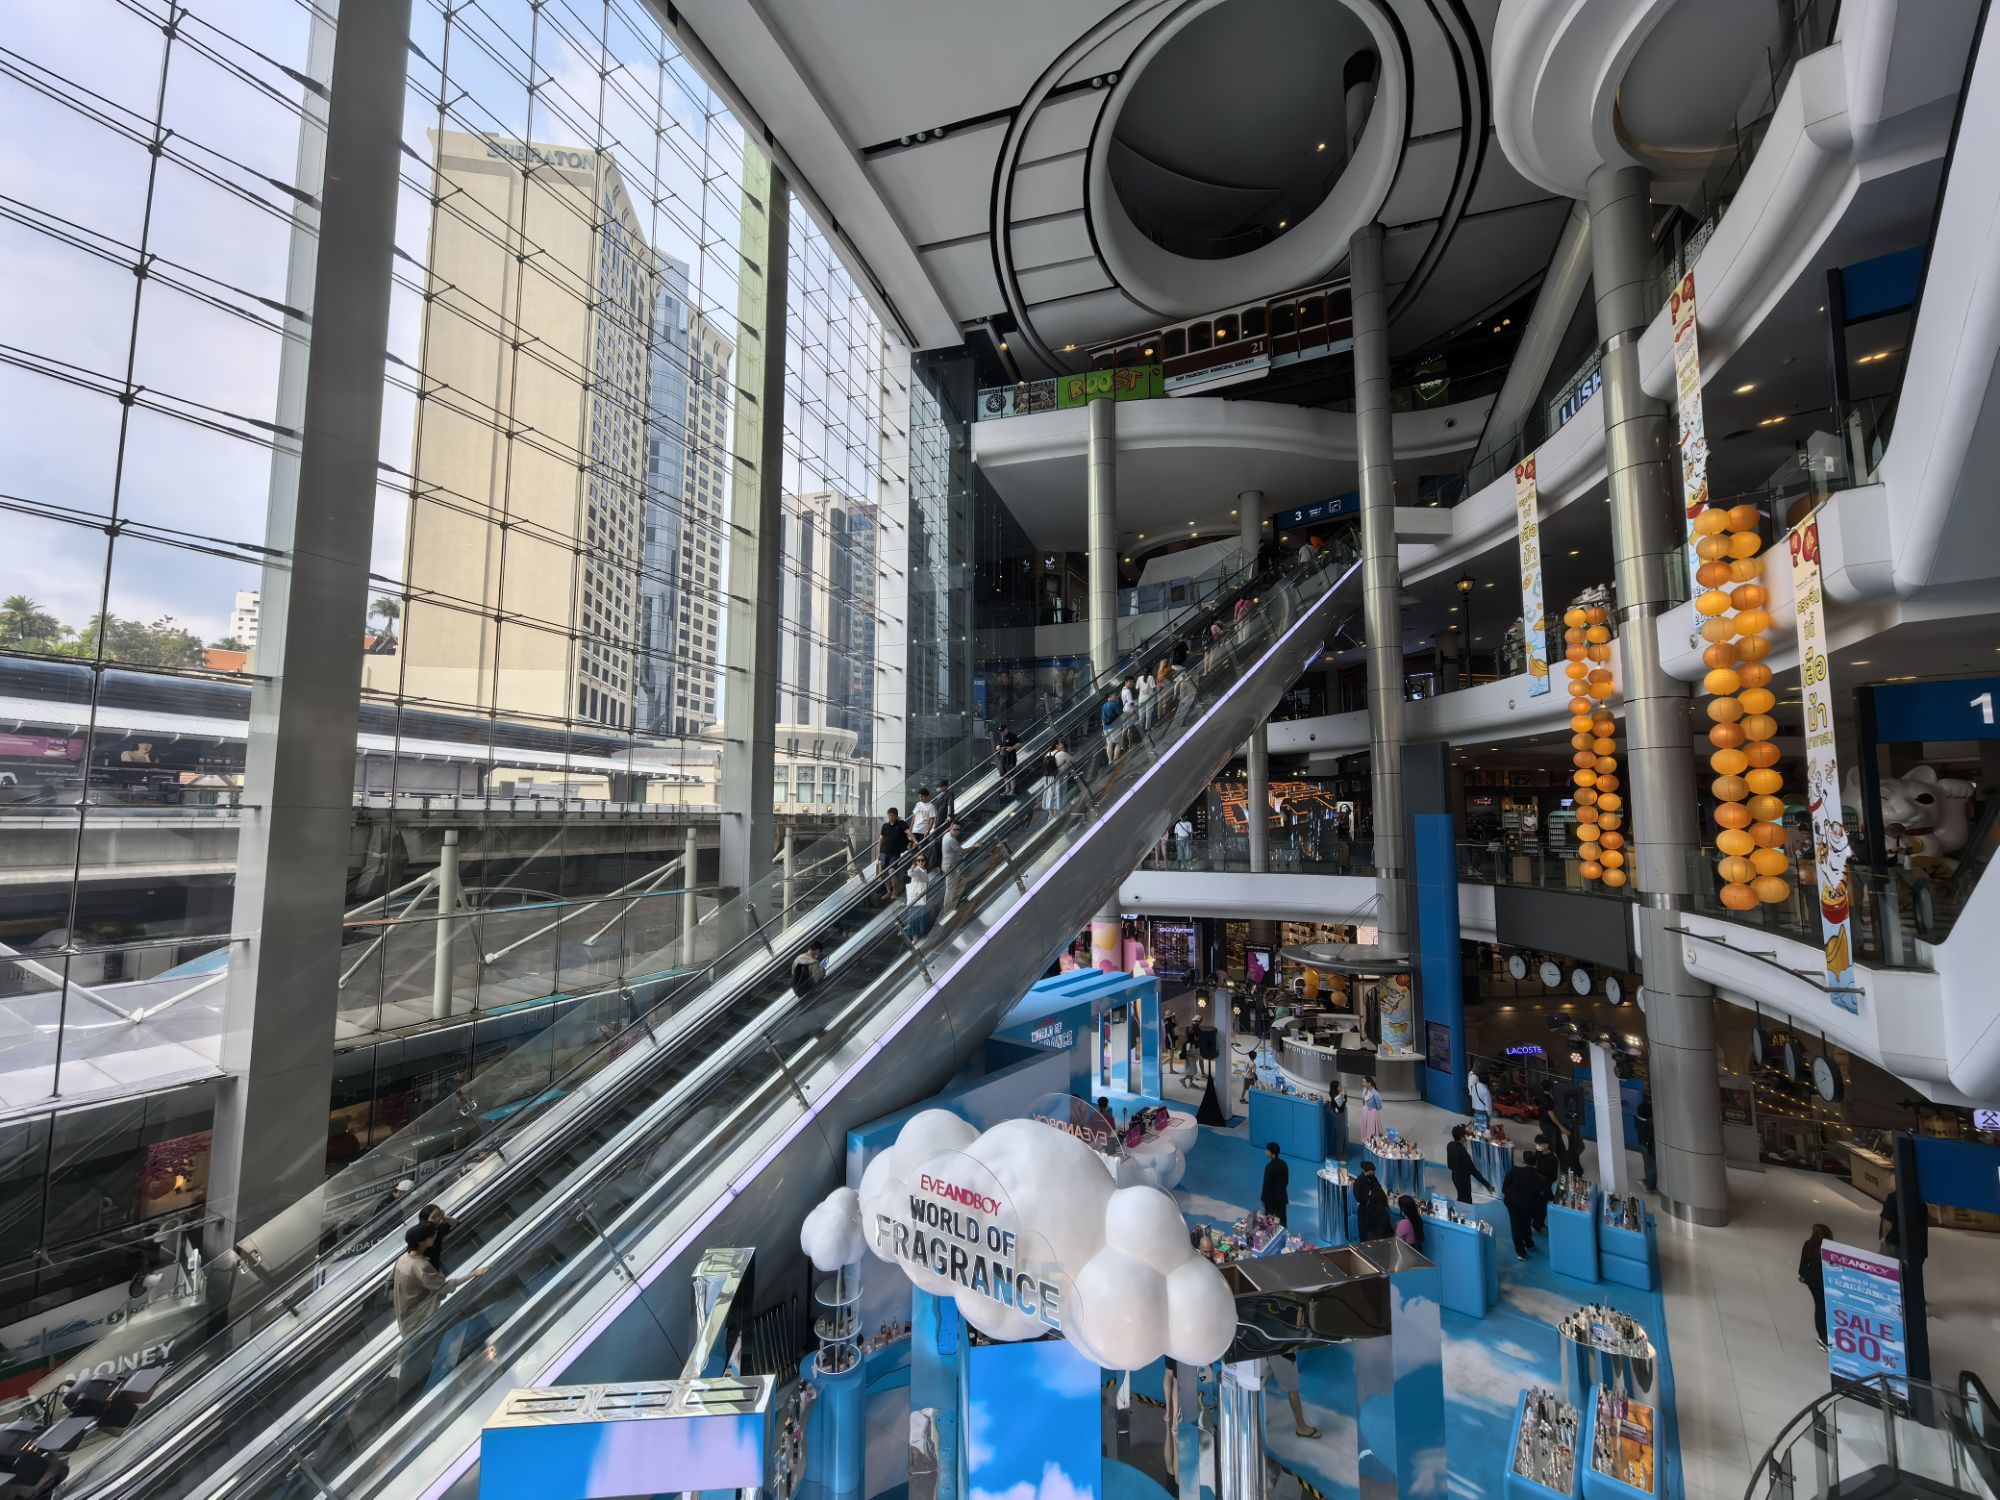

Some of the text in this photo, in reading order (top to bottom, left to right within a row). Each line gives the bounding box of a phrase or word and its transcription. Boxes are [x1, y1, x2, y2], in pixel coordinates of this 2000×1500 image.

[486, 142, 595, 170] SHERATON
[1251, 341, 1264, 354] 21
[1068, 368, 1144, 401] BOOST
[1295, 511, 1302, 521] 3
[1970, 692, 1995, 724] 1
[1505, 1046, 1542, 1055] LACOSTE
[921, 1174, 1002, 1216] EVEANDBOY
[909, 1195, 1017, 1258] WORLD OF
[875, 1213, 1062, 1330] FRAGRANCE
[1830, 1253, 1889, 1276] EVEANDBOY
[1833, 1309, 1895, 1343] SALE
